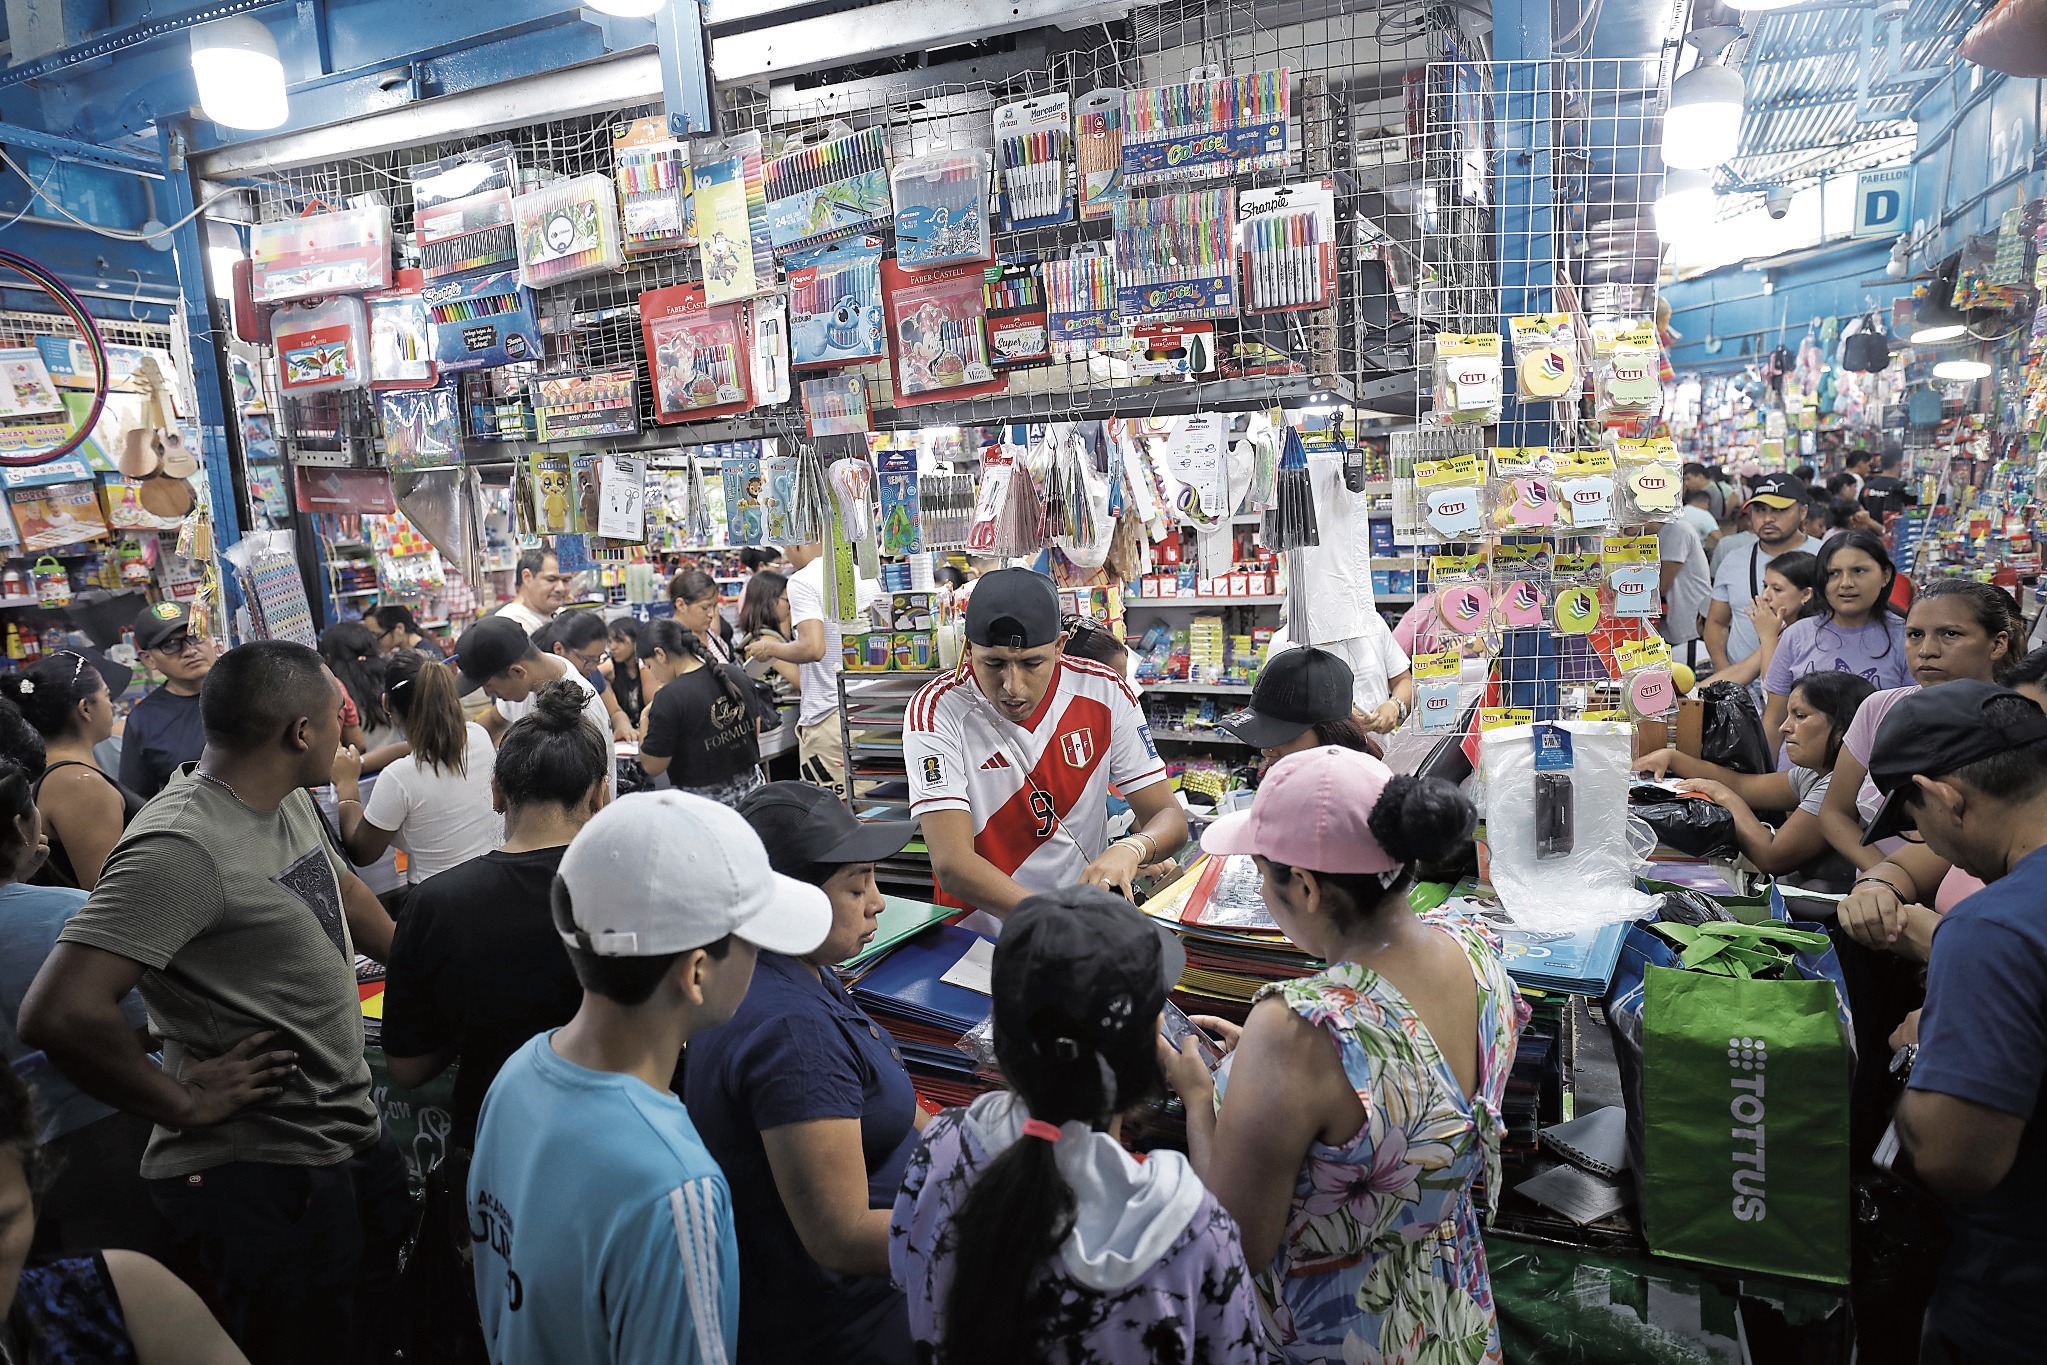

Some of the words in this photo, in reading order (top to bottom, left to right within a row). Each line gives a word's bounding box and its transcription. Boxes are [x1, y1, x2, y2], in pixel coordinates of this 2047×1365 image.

[1031, 101, 1066, 119] Marcador
[1060, 112, 1068, 120] 8
[1167, 132, 1228, 165] ColorGel
[1860, 170, 1909, 184] PABELLON
[1239, 196, 1289, 221] Sharpie
[1864, 190, 1900, 226] D
[775, 217, 786, 228] 24
[910, 268, 964, 284] FABER-CASTELL
[425, 281, 461, 306] Sharpie
[1149, 282, 1193, 308] ColorGel
[1000, 321, 1036, 330] FABER-CASTELL
[997, 337, 1022, 350] Super
[1022, 339, 1042, 354] Soft
[437, 361, 446, 370] 20
[1460, 373, 1487, 384] TITI
[1616, 369, 1643, 380] TITI
[536, 460, 569, 471] alpha
[1418, 469, 1436, 477] TITI
[1640, 477, 1666, 489] TITI
[1574, 491, 1601, 503] TITI
[1755, 486, 1775, 496] PUMA
[1440, 502, 1466, 515] TITI
[1622, 583, 1644, 594] TITI
[871, 641, 888, 649] CHALK
[1646, 644, 1661, 652] STICKY
[1642, 685, 1663, 696] TITI
[1429, 697, 1448, 709] TITI
[1028, 790, 1055, 838] 9
[1730, 1074, 1767, 1223] TOTTUS
